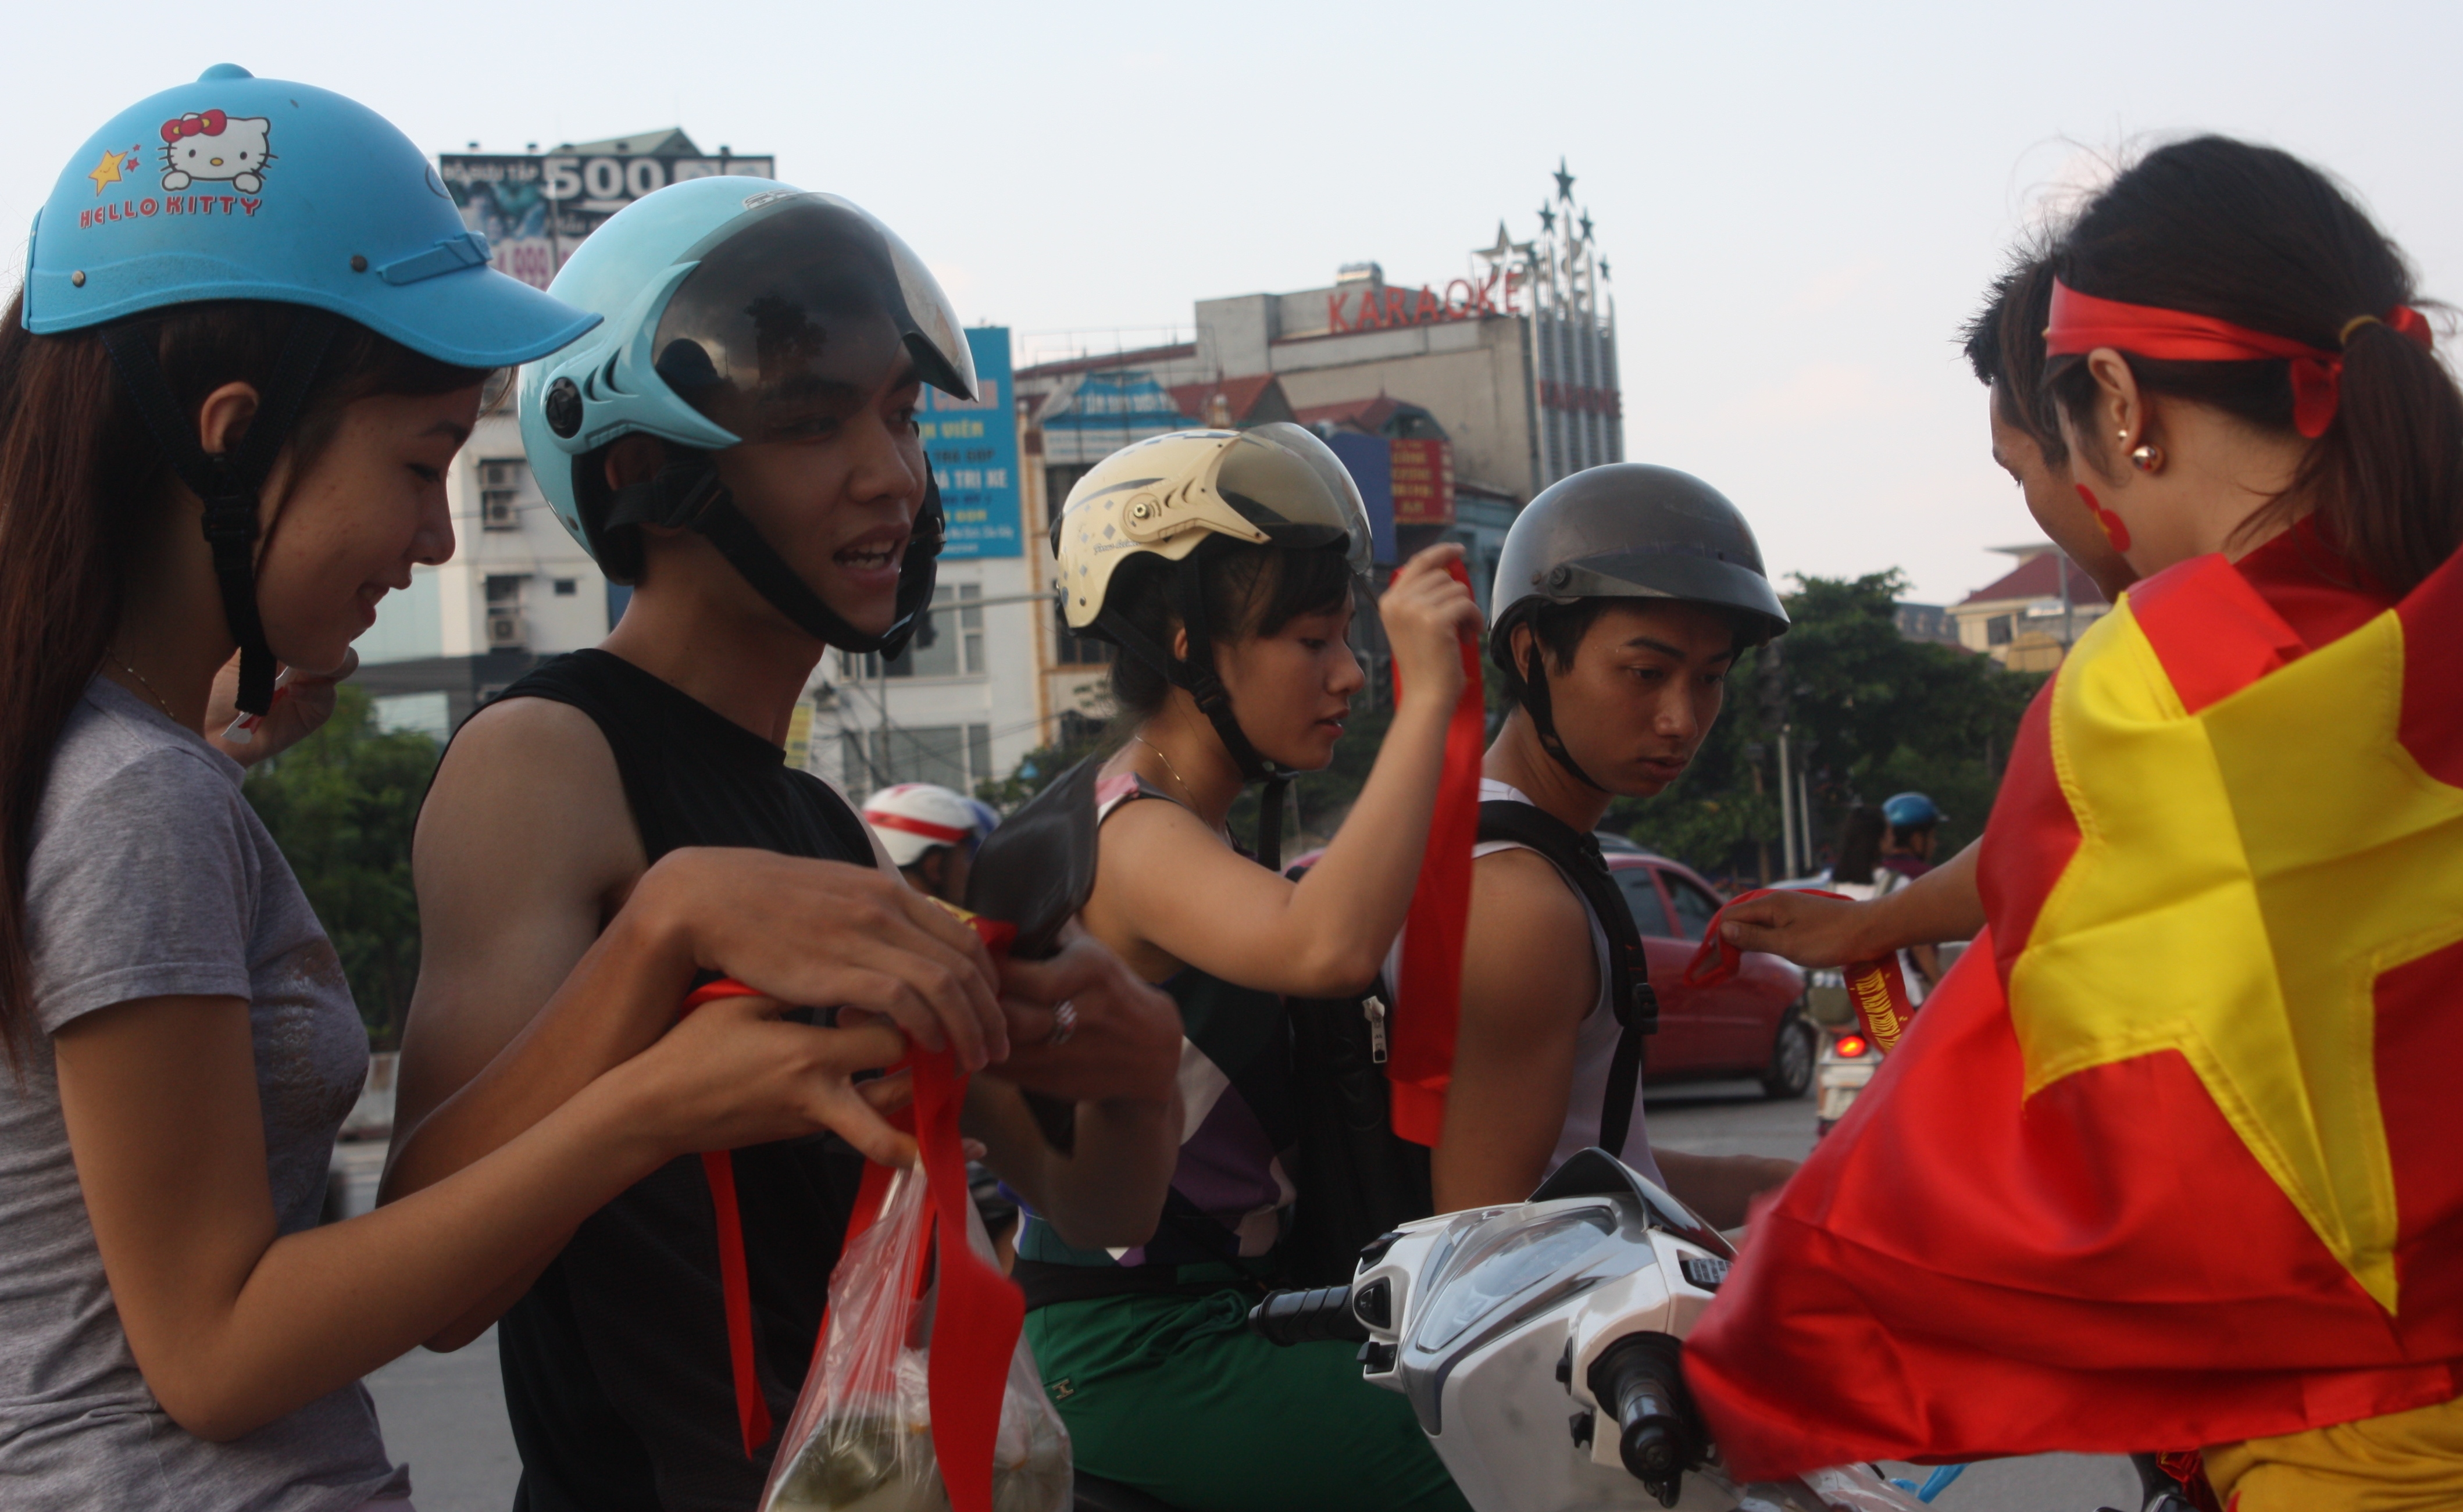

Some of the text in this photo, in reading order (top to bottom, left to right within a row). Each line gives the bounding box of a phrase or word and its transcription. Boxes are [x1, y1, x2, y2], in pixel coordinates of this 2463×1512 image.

[542, 158, 665, 199] 500
[80, 195, 260, 229] HELLO KITTY
[1327, 269, 1521, 335] KARAOKE
